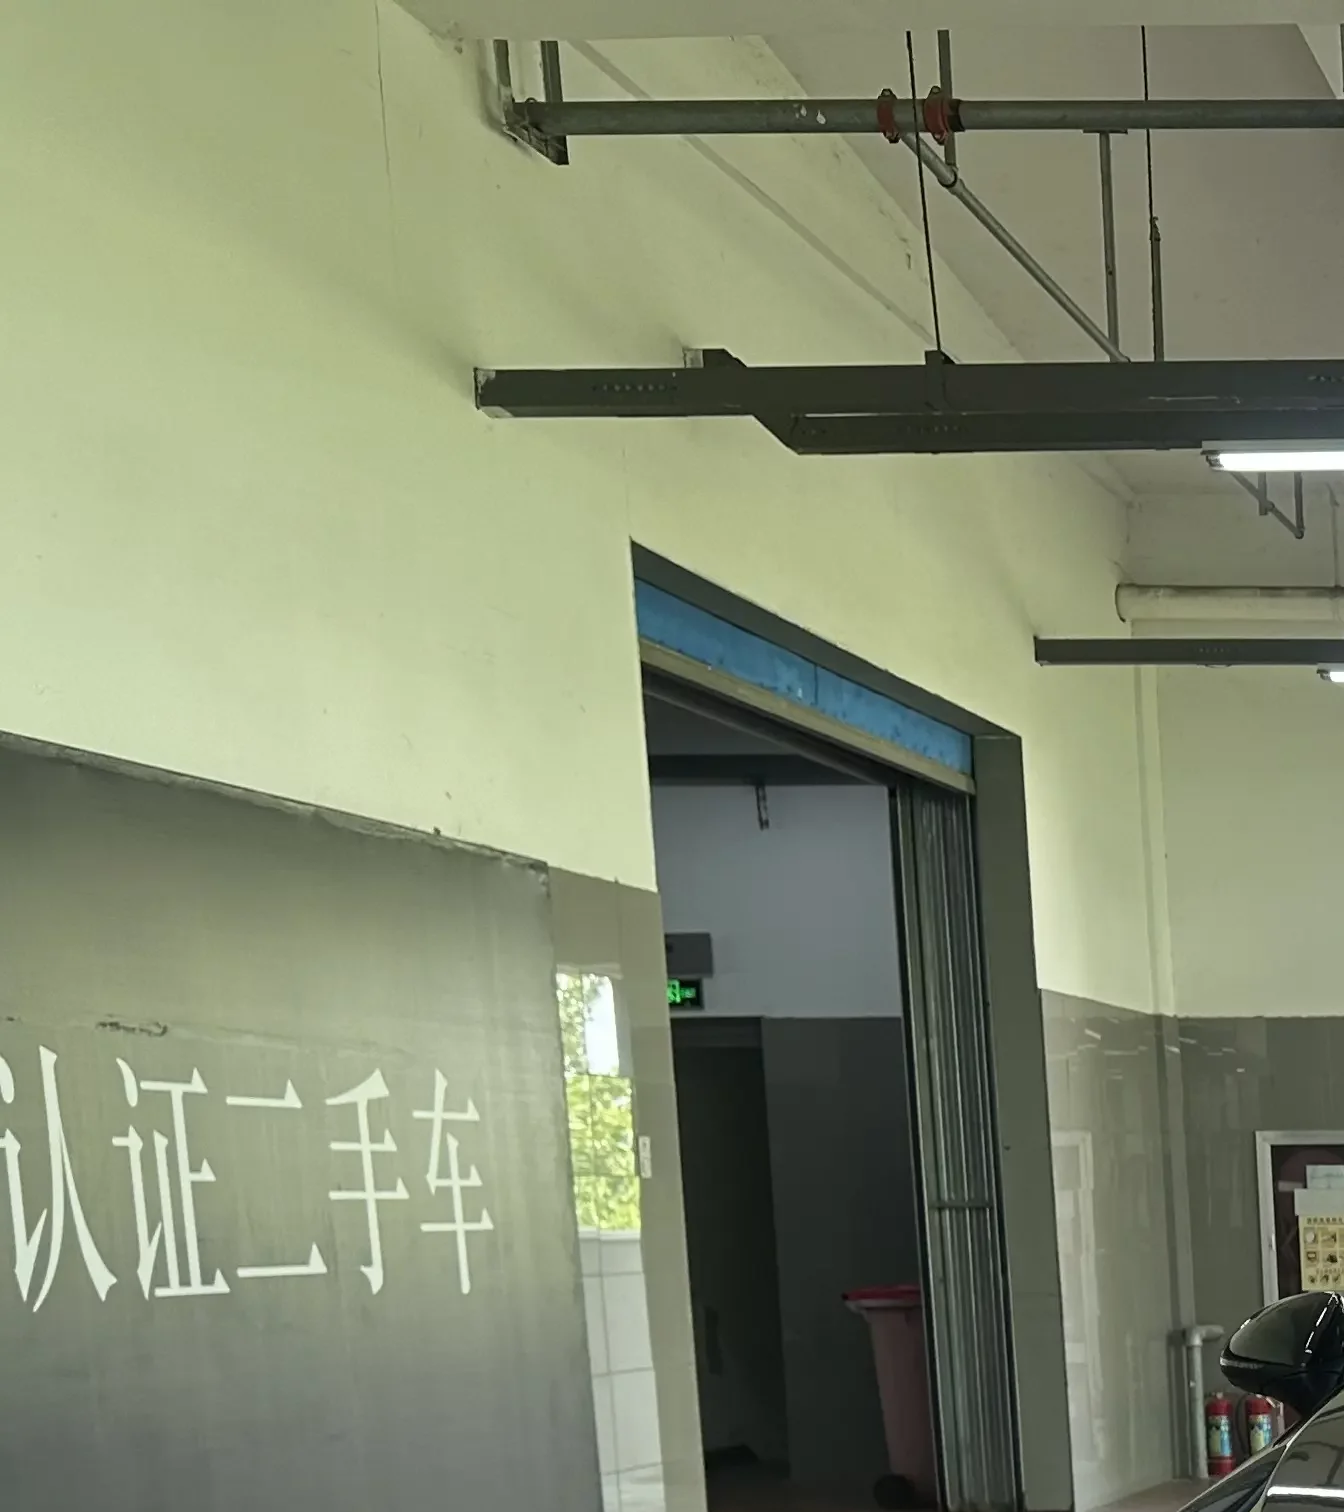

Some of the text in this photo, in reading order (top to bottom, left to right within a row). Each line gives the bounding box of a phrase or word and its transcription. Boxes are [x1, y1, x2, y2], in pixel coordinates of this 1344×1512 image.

[0, 1046, 494, 1312] 认证二手车
